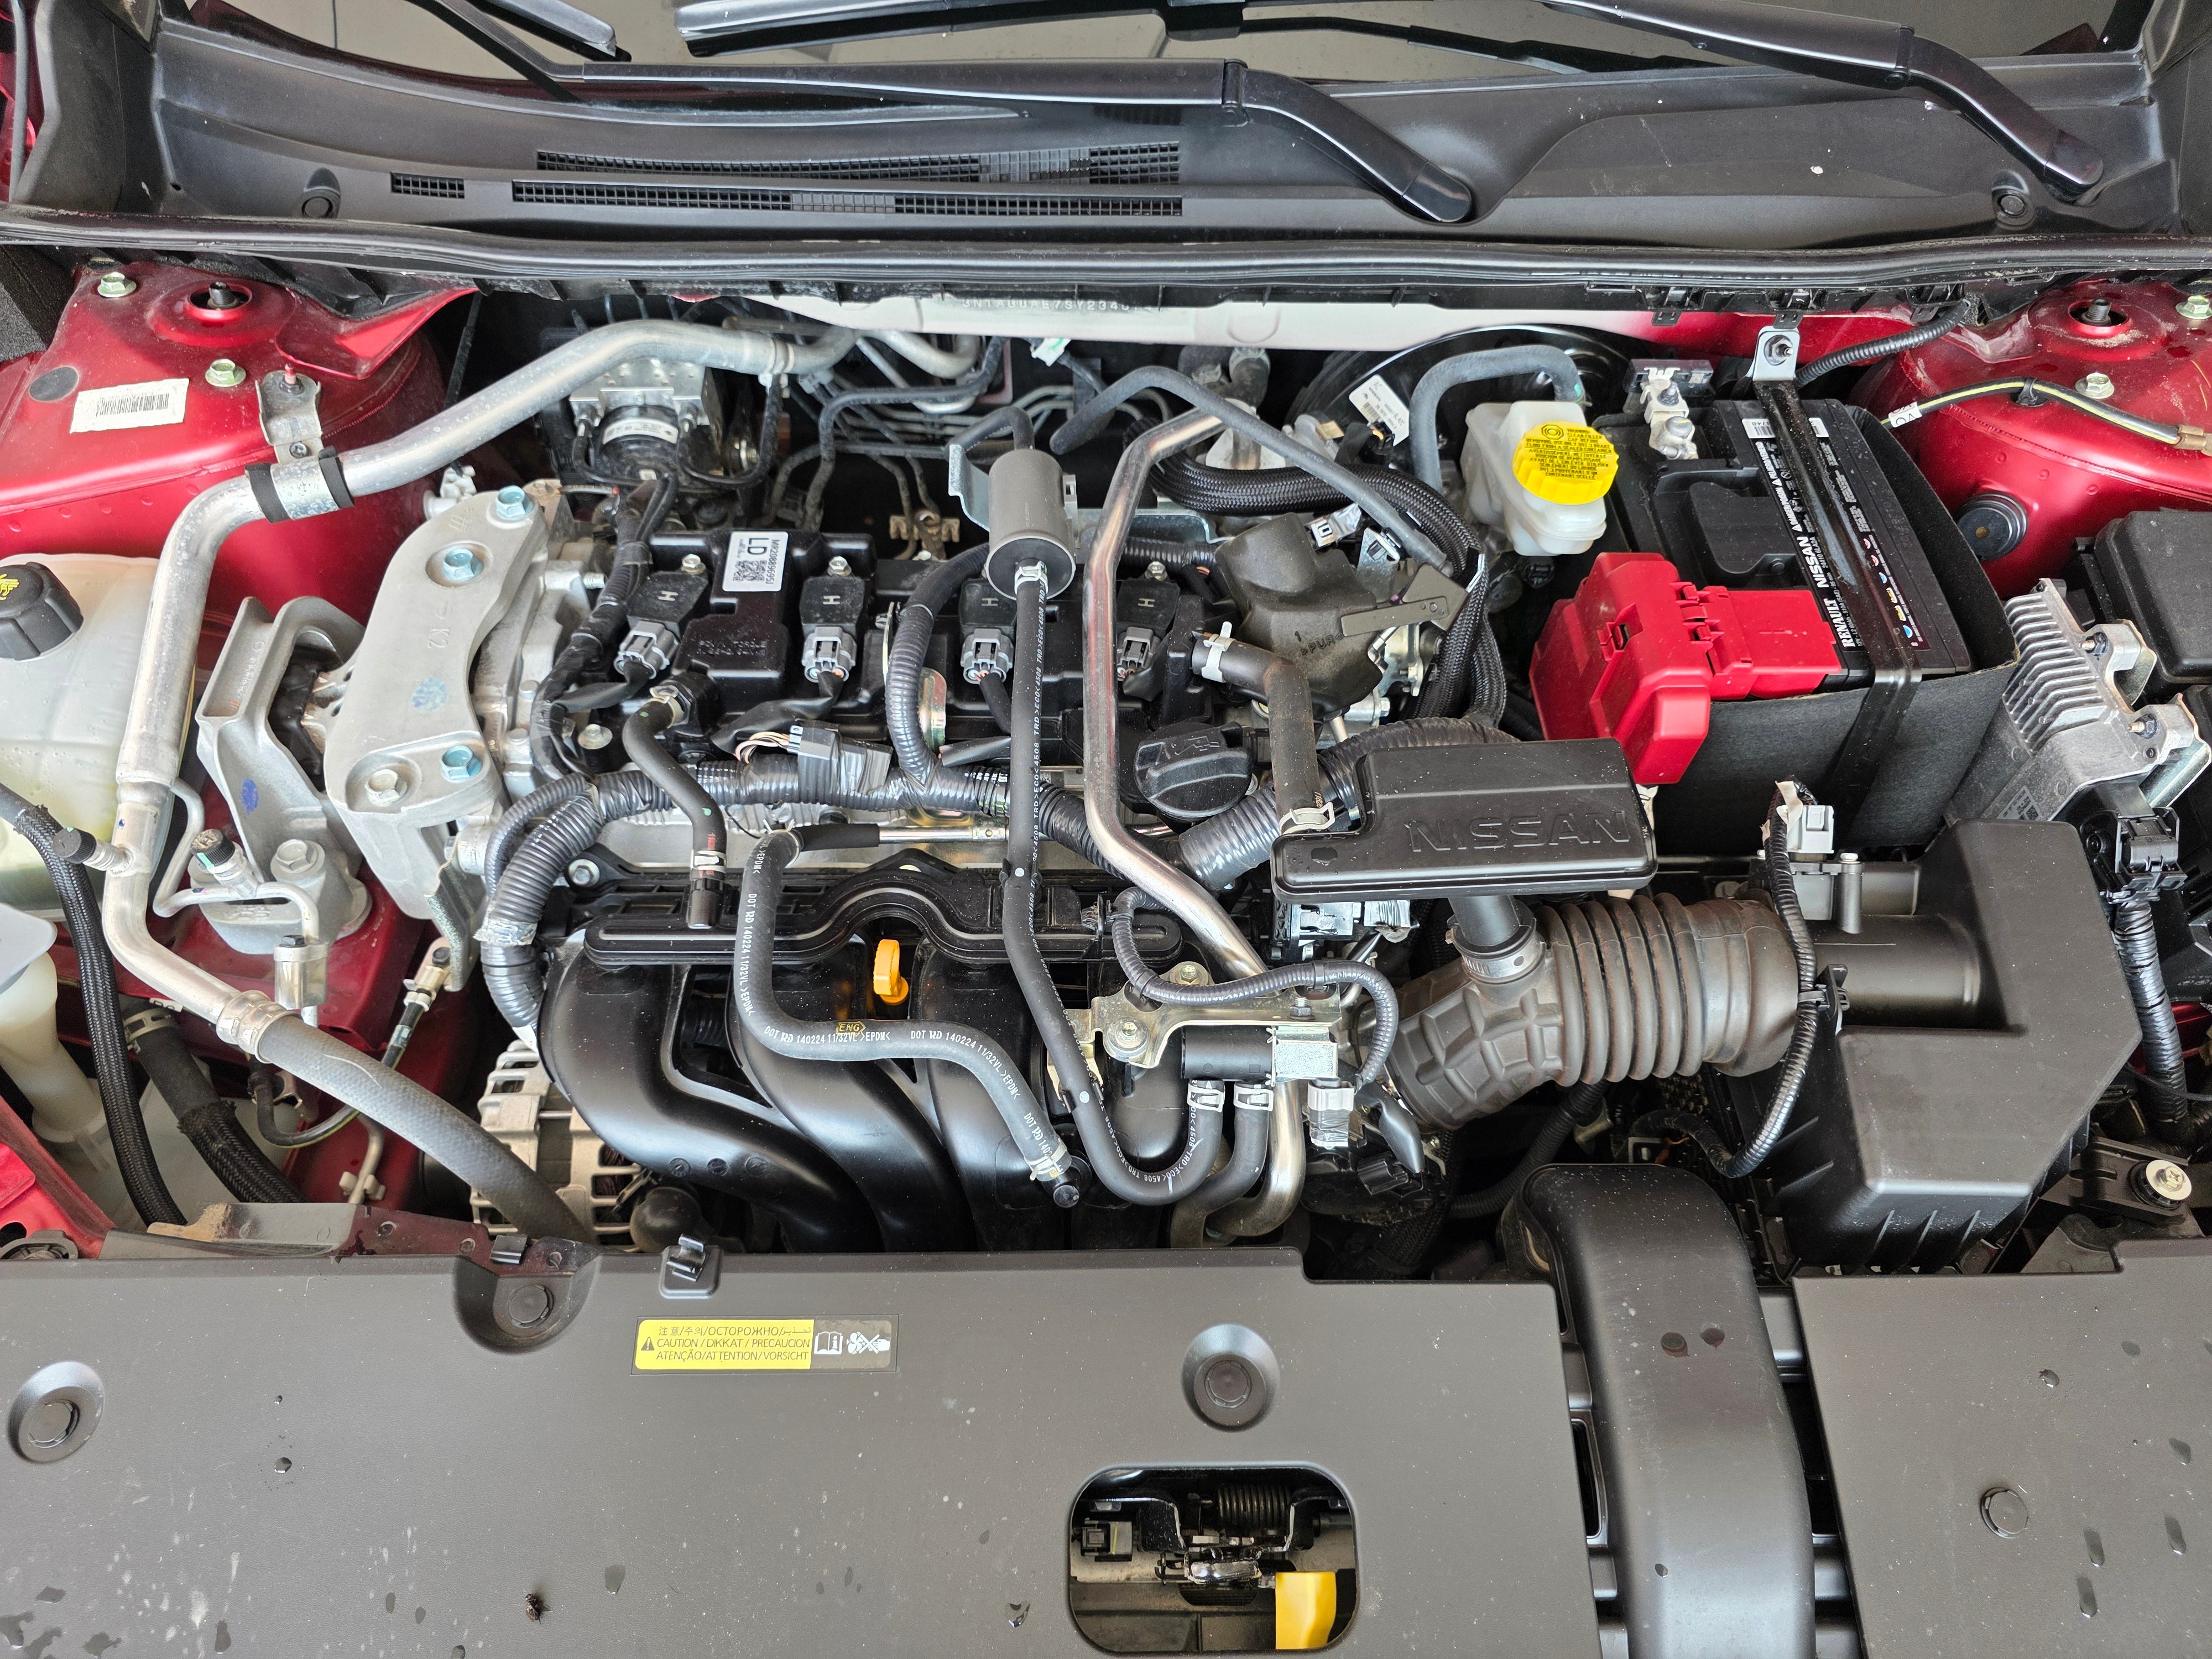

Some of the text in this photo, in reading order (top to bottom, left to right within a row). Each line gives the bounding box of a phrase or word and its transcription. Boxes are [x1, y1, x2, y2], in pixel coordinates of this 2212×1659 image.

[747, 538, 769, 555] LD
[1797, 536, 1856, 648] RENAULT NISSAN
[1404, 810, 1631, 852] NISSAN
[748, 893, 757, 909] DOT
[742, 926, 753, 953] 140224
[764, 1025, 780, 1040] DOT
[797, 1034, 825, 1044] 140224
[839, 1023, 860, 1032] ENG
[911, 1030, 926, 1040] DOT
[946, 1032, 977, 1050] 140224
[1024, 1112, 1037, 1128] DOT
[657, 1338, 698, 1348] CAUTION
[706, 1338, 743, 1348] DIKKAT
[752, 1338, 810, 1348] PRECAUCION
